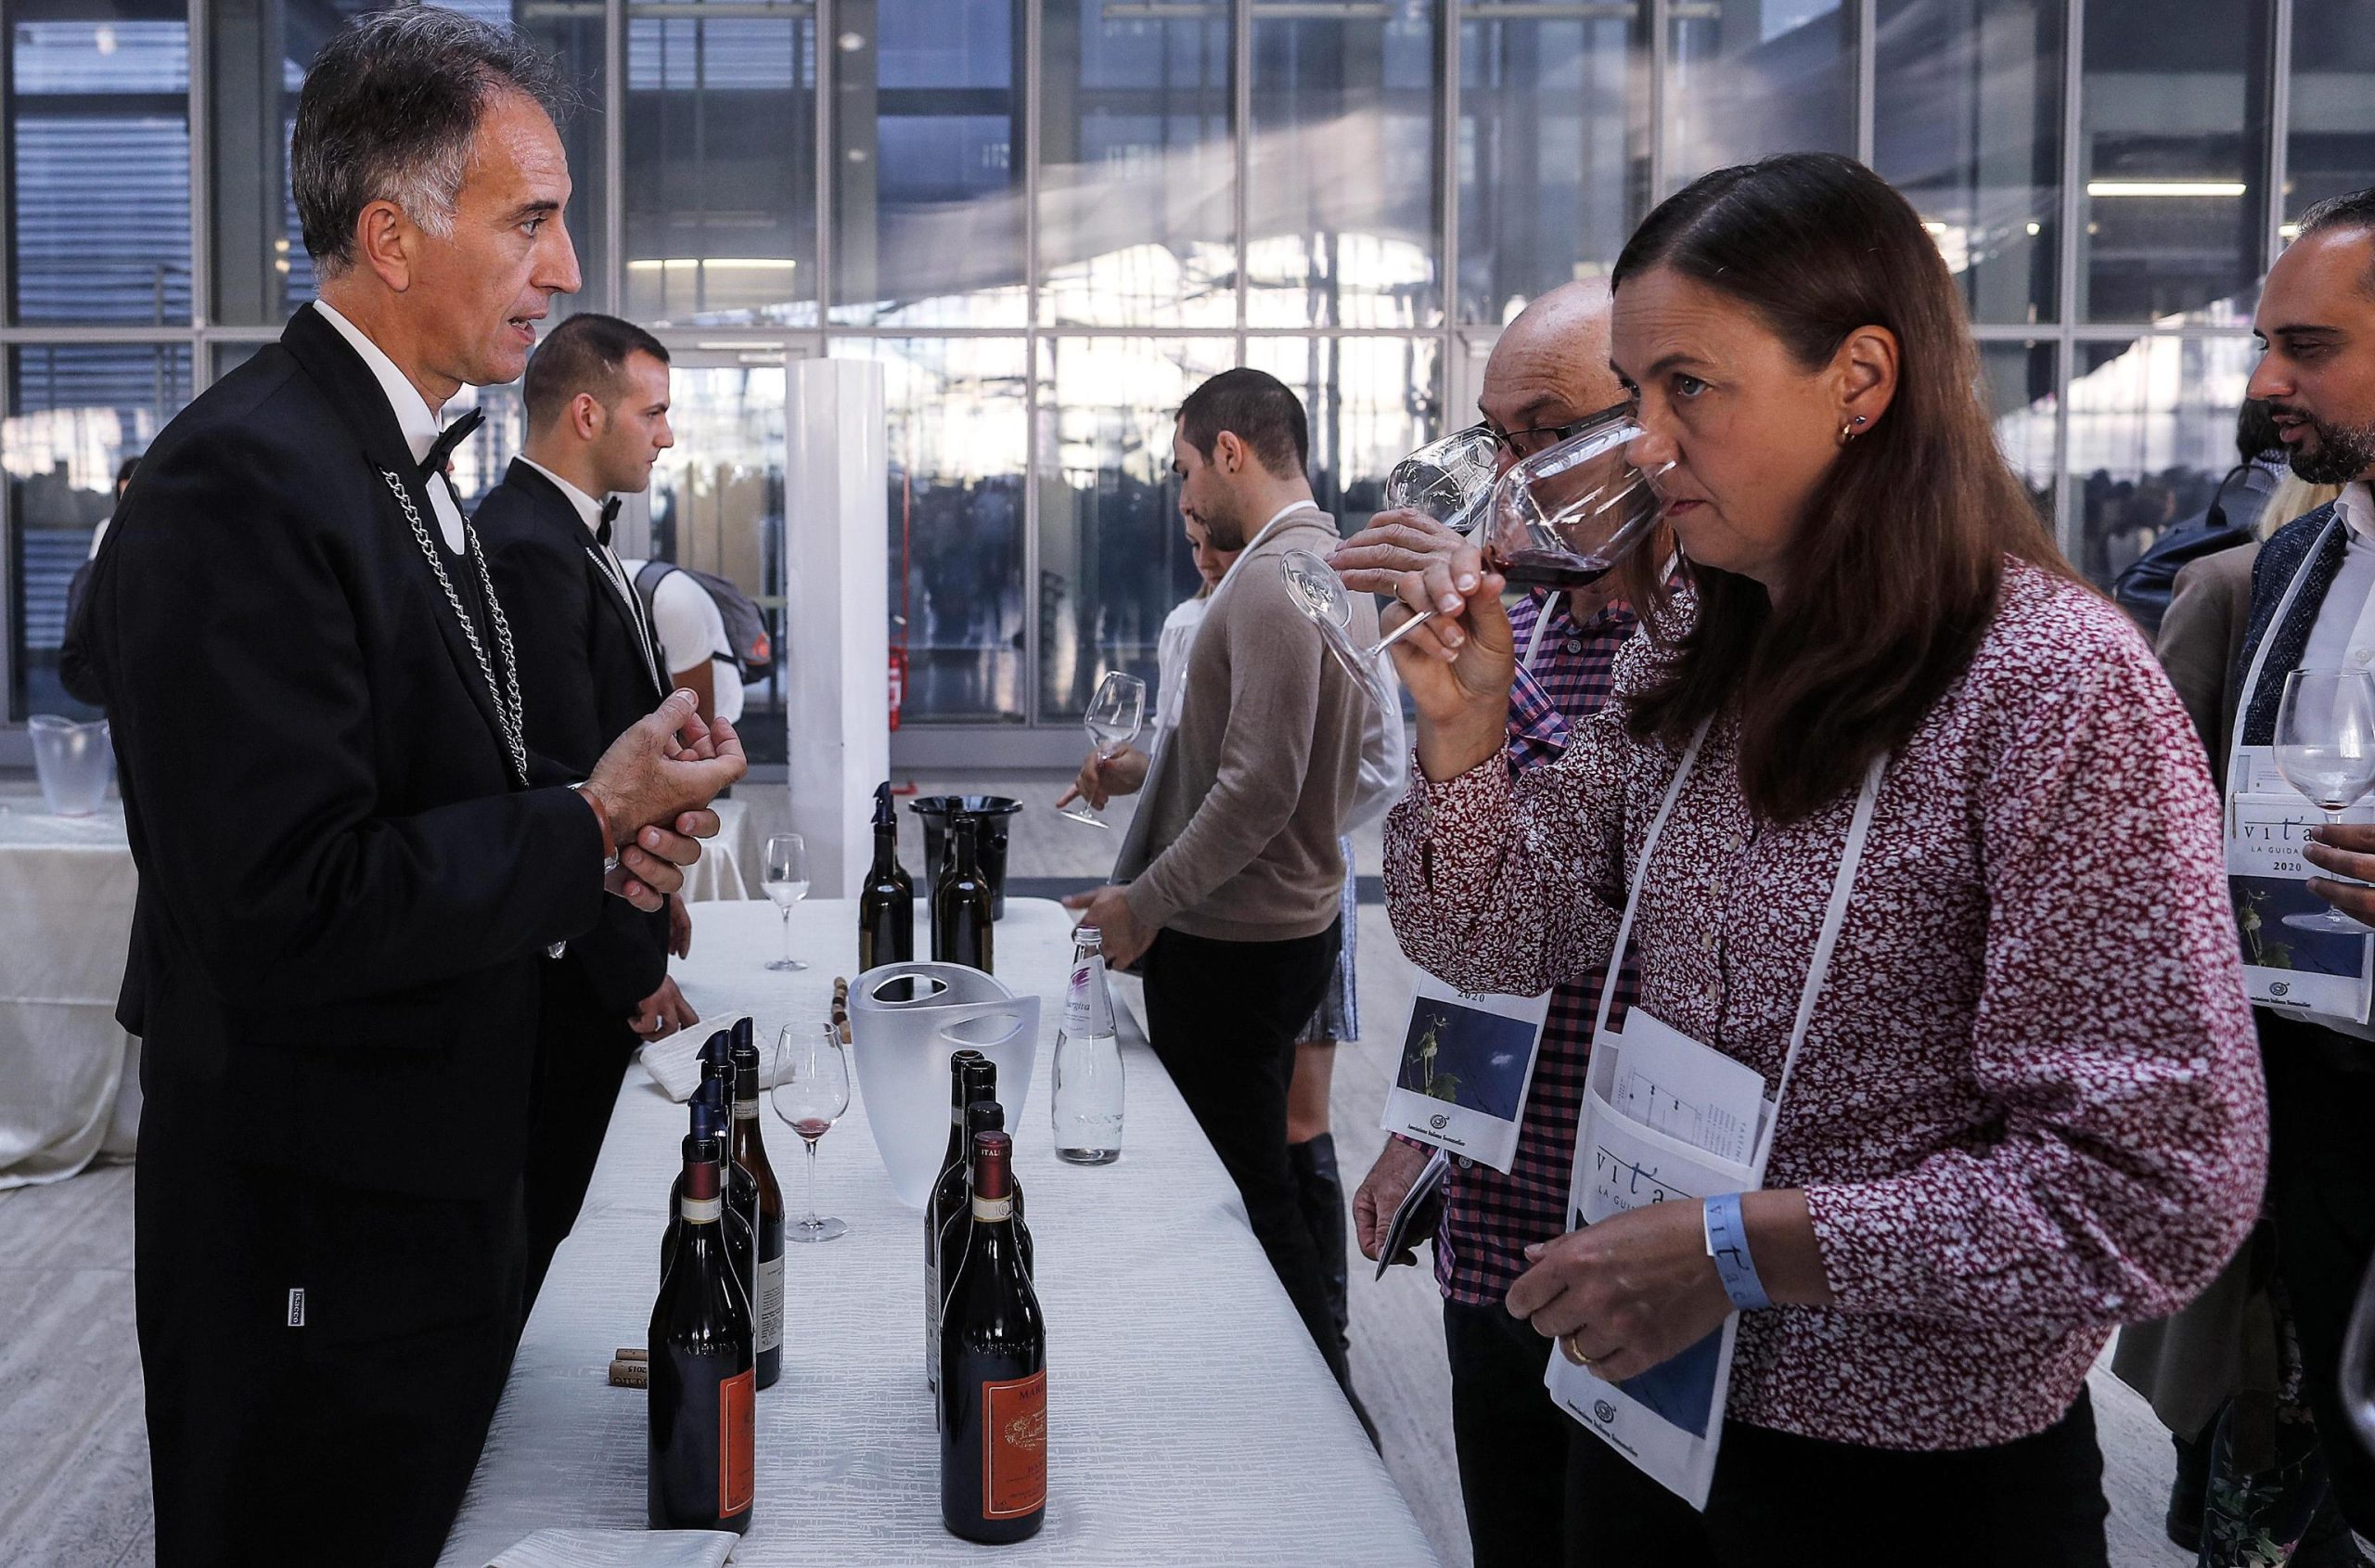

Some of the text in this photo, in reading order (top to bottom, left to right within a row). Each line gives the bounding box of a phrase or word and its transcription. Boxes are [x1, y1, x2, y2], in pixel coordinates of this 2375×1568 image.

[2244, 816, 2314, 842] vita
[2273, 861, 2302, 872] 2020
[1457, 991, 1484, 1002] 2020
[1597, 1152, 1664, 1204] vita
